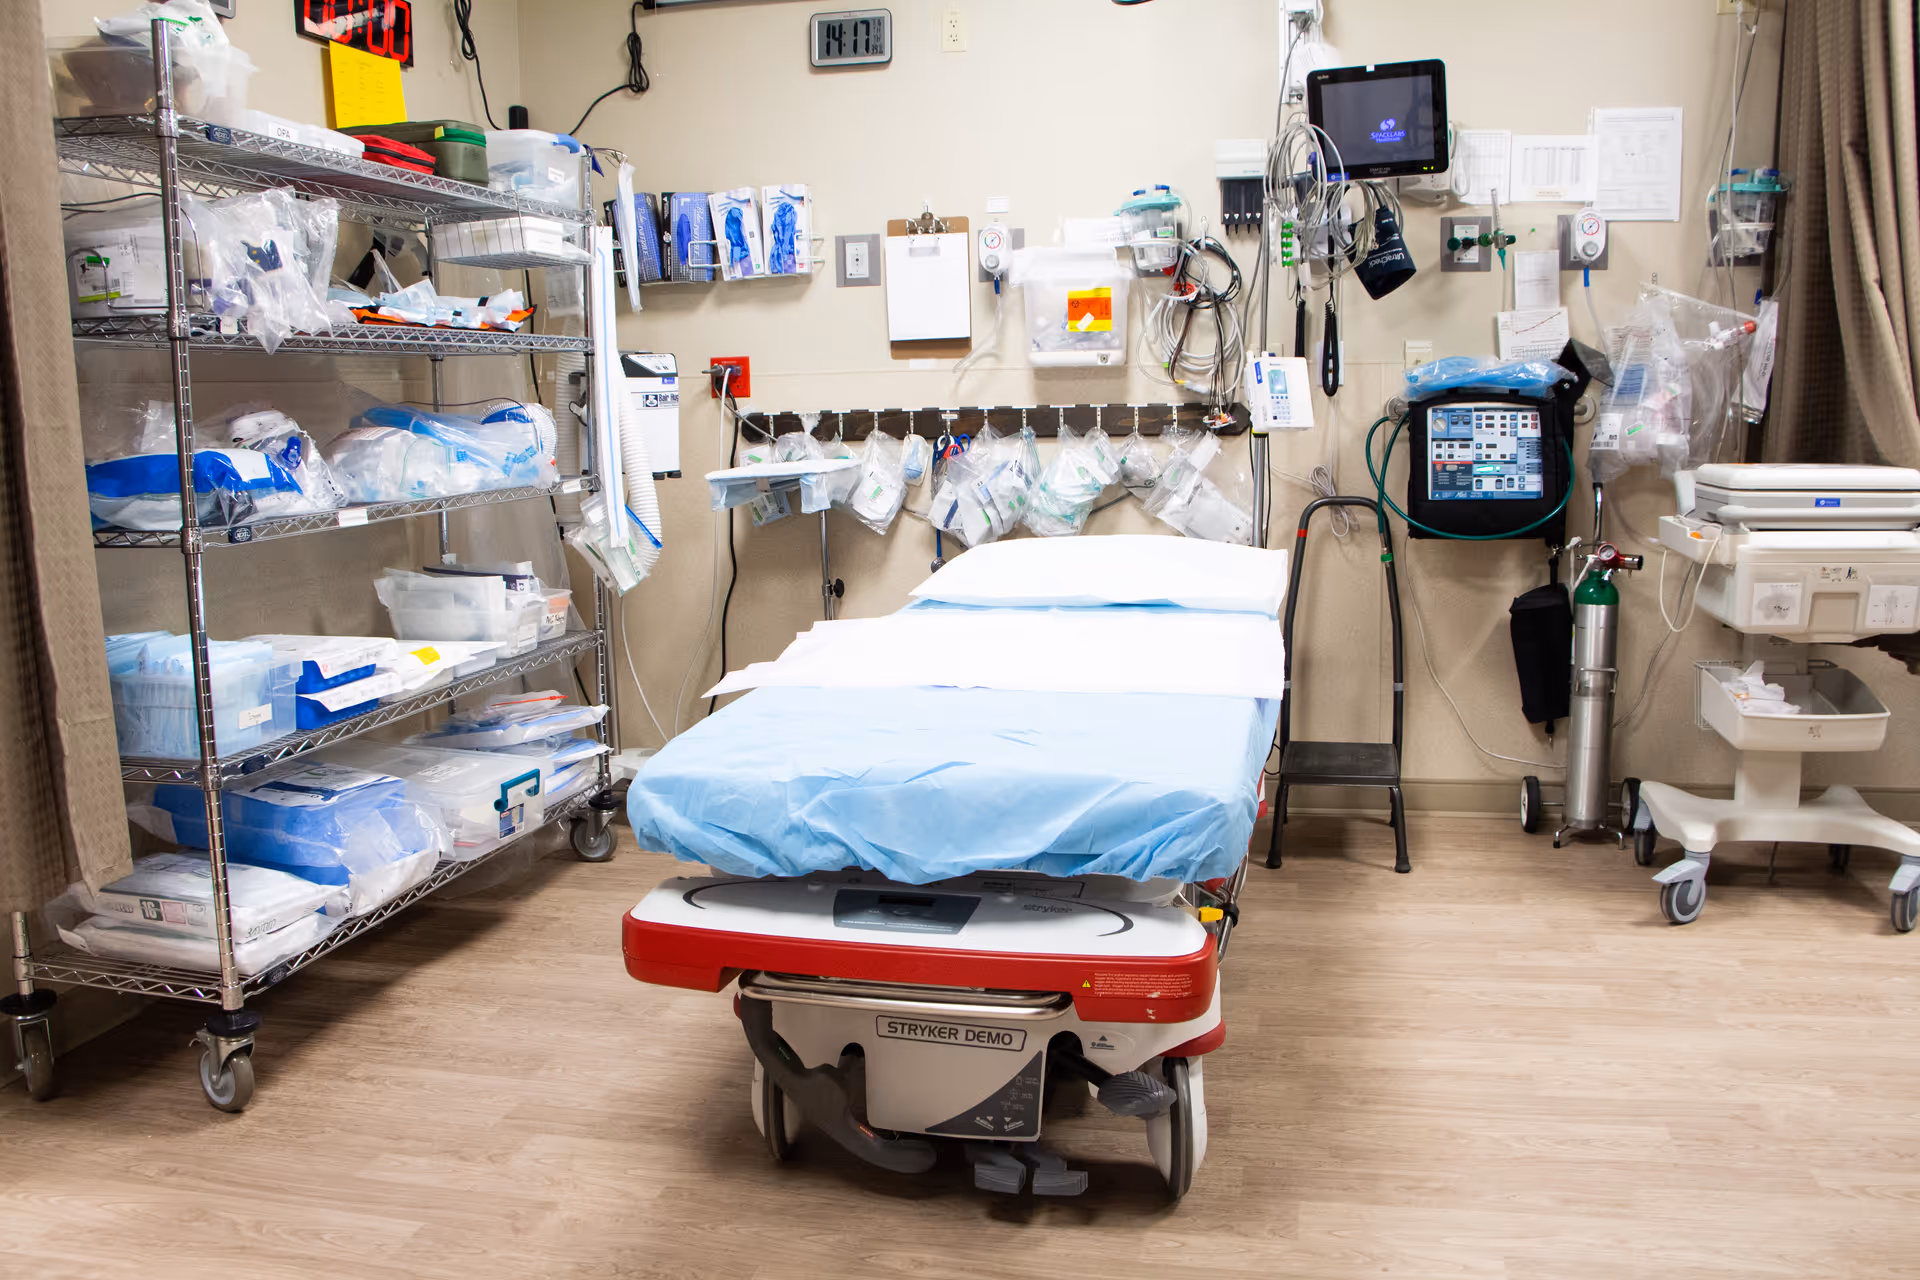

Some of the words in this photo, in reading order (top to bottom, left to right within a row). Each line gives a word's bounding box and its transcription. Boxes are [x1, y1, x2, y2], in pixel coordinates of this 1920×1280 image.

[826, 20, 870, 56] 14:17
[276, 127, 291, 140] OPA
[1368, 252, 1405, 268] UltraCheck
[1023, 902, 1073, 914] stryker
[887, 1021, 959, 1040] STRYKER
[964, 1029, 1013, 1046] DEMO
